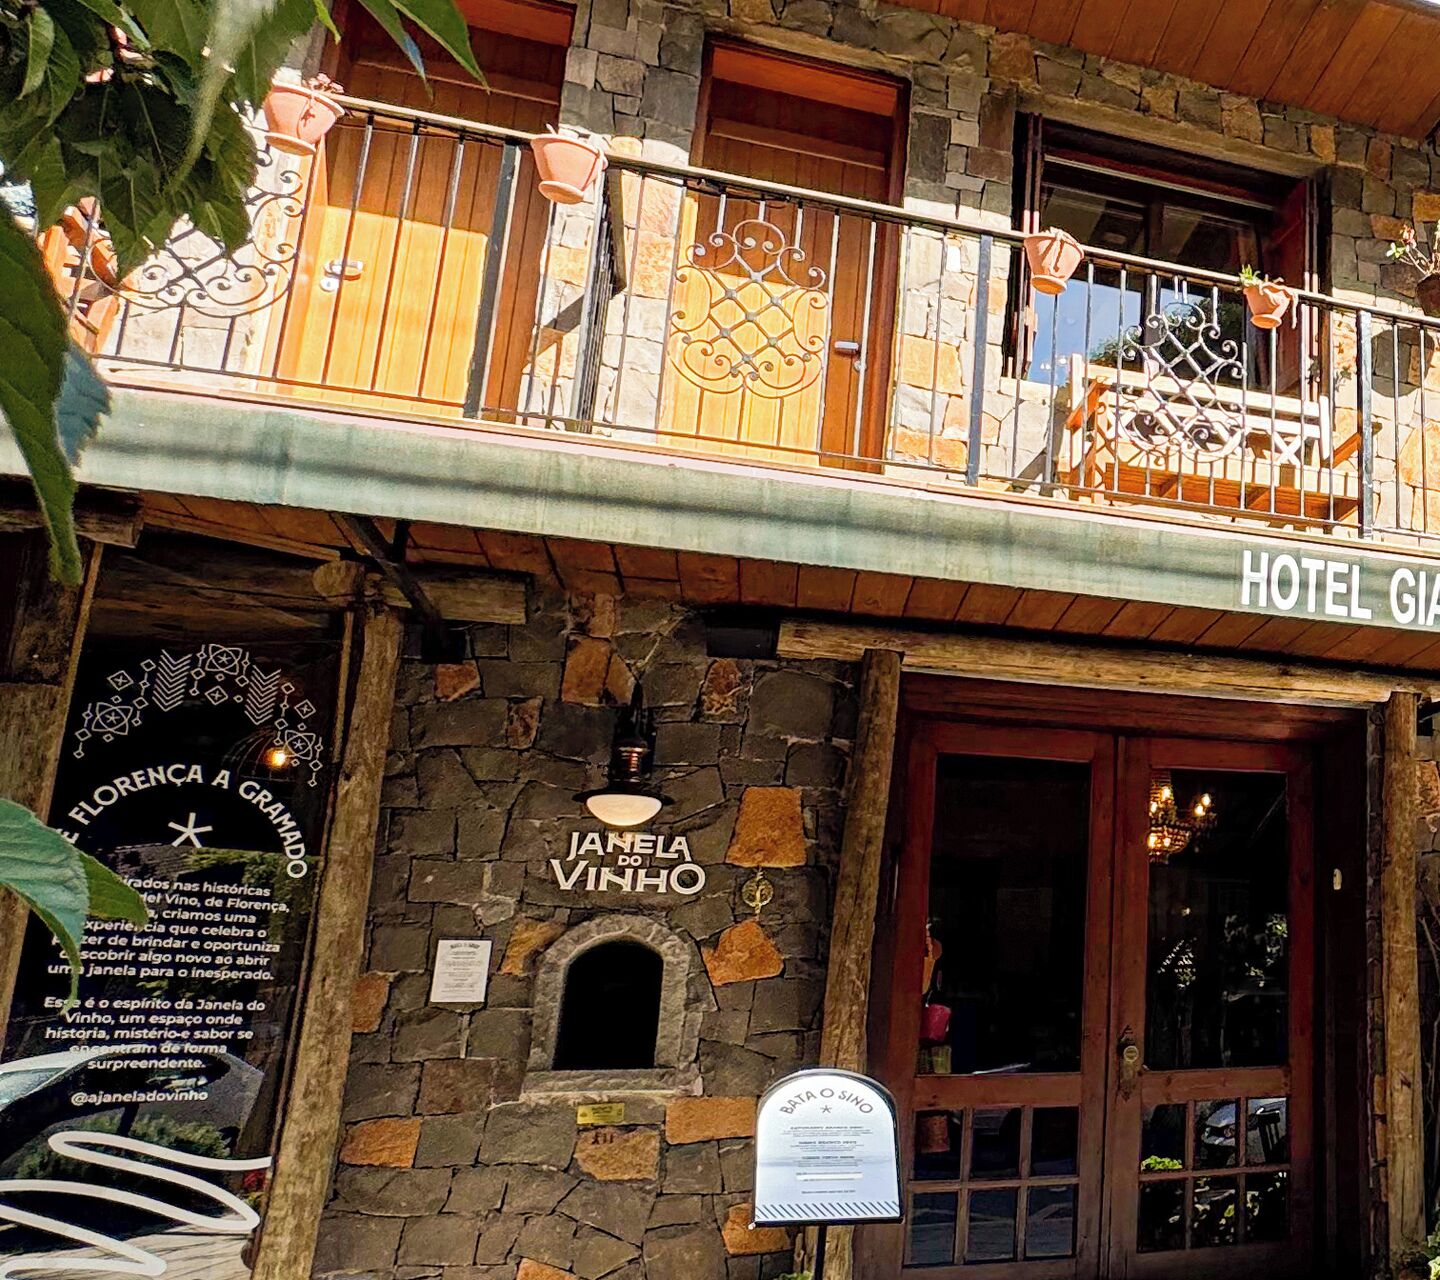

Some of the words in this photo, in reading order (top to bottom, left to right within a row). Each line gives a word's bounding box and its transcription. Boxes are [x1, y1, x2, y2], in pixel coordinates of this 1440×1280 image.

[1240, 548, 1373, 620] HOTEL
[68, 763, 205, 826] FLORENÇA
[211, 769, 231, 790] A
[238, 780, 309, 879] GRAMADO
[566, 831, 692, 862] JANELA
[617, 854, 643, 867] DO
[549, 858, 707, 896] VINHO
[172, 881, 200, 892] nas
[202, 881, 271, 897] históricas
[164, 892, 201, 908] Vino,
[204, 895, 223, 908] de
[226, 897, 290, 914] Florença,
[162, 908, 222, 922] criamos
[224, 912, 257, 924] uma
[169, 924, 199, 936] que
[201, 925, 255, 938] celebra
[257, 928, 267, 938] o
[107, 934, 128, 947] de
[131, 935, 189, 950] brindar
[191, 940, 200, 949] e
[203, 940, 280, 953] oportuniza
[138, 949, 172, 965] algo
[175, 953, 212, 964] novo
[215, 955, 233, 965] ao
[235, 954, 271, 967] abrir
[86, 963, 137, 978] janela
[140, 967, 174, 979] para
[178, 968, 188, 977] o
[191, 966, 274, 981] inesperado.
[99, 999, 109, 1008] o
[174, 998, 194, 1010] da
[196, 999, 243, 1011] Janela
[246, 1000, 266, 1011] do
[65, 1011, 115, 1026] Vinho,
[119, 1014, 146, 1024] um
[149, 1014, 203, 1027] espaço
[205, 1013, 243, 1025] onde
[193, 1027, 235, 1039] sabor
[237, 1030, 254, 1040] se
[160, 1041, 181, 1053] de
[183, 1042, 227, 1054] forma
[87, 1057, 206, 1072] surpreendente.
[780, 1090, 818, 1115] BATA
[819, 1087, 835, 1099] O
[837, 1090, 874, 1114] SINO
